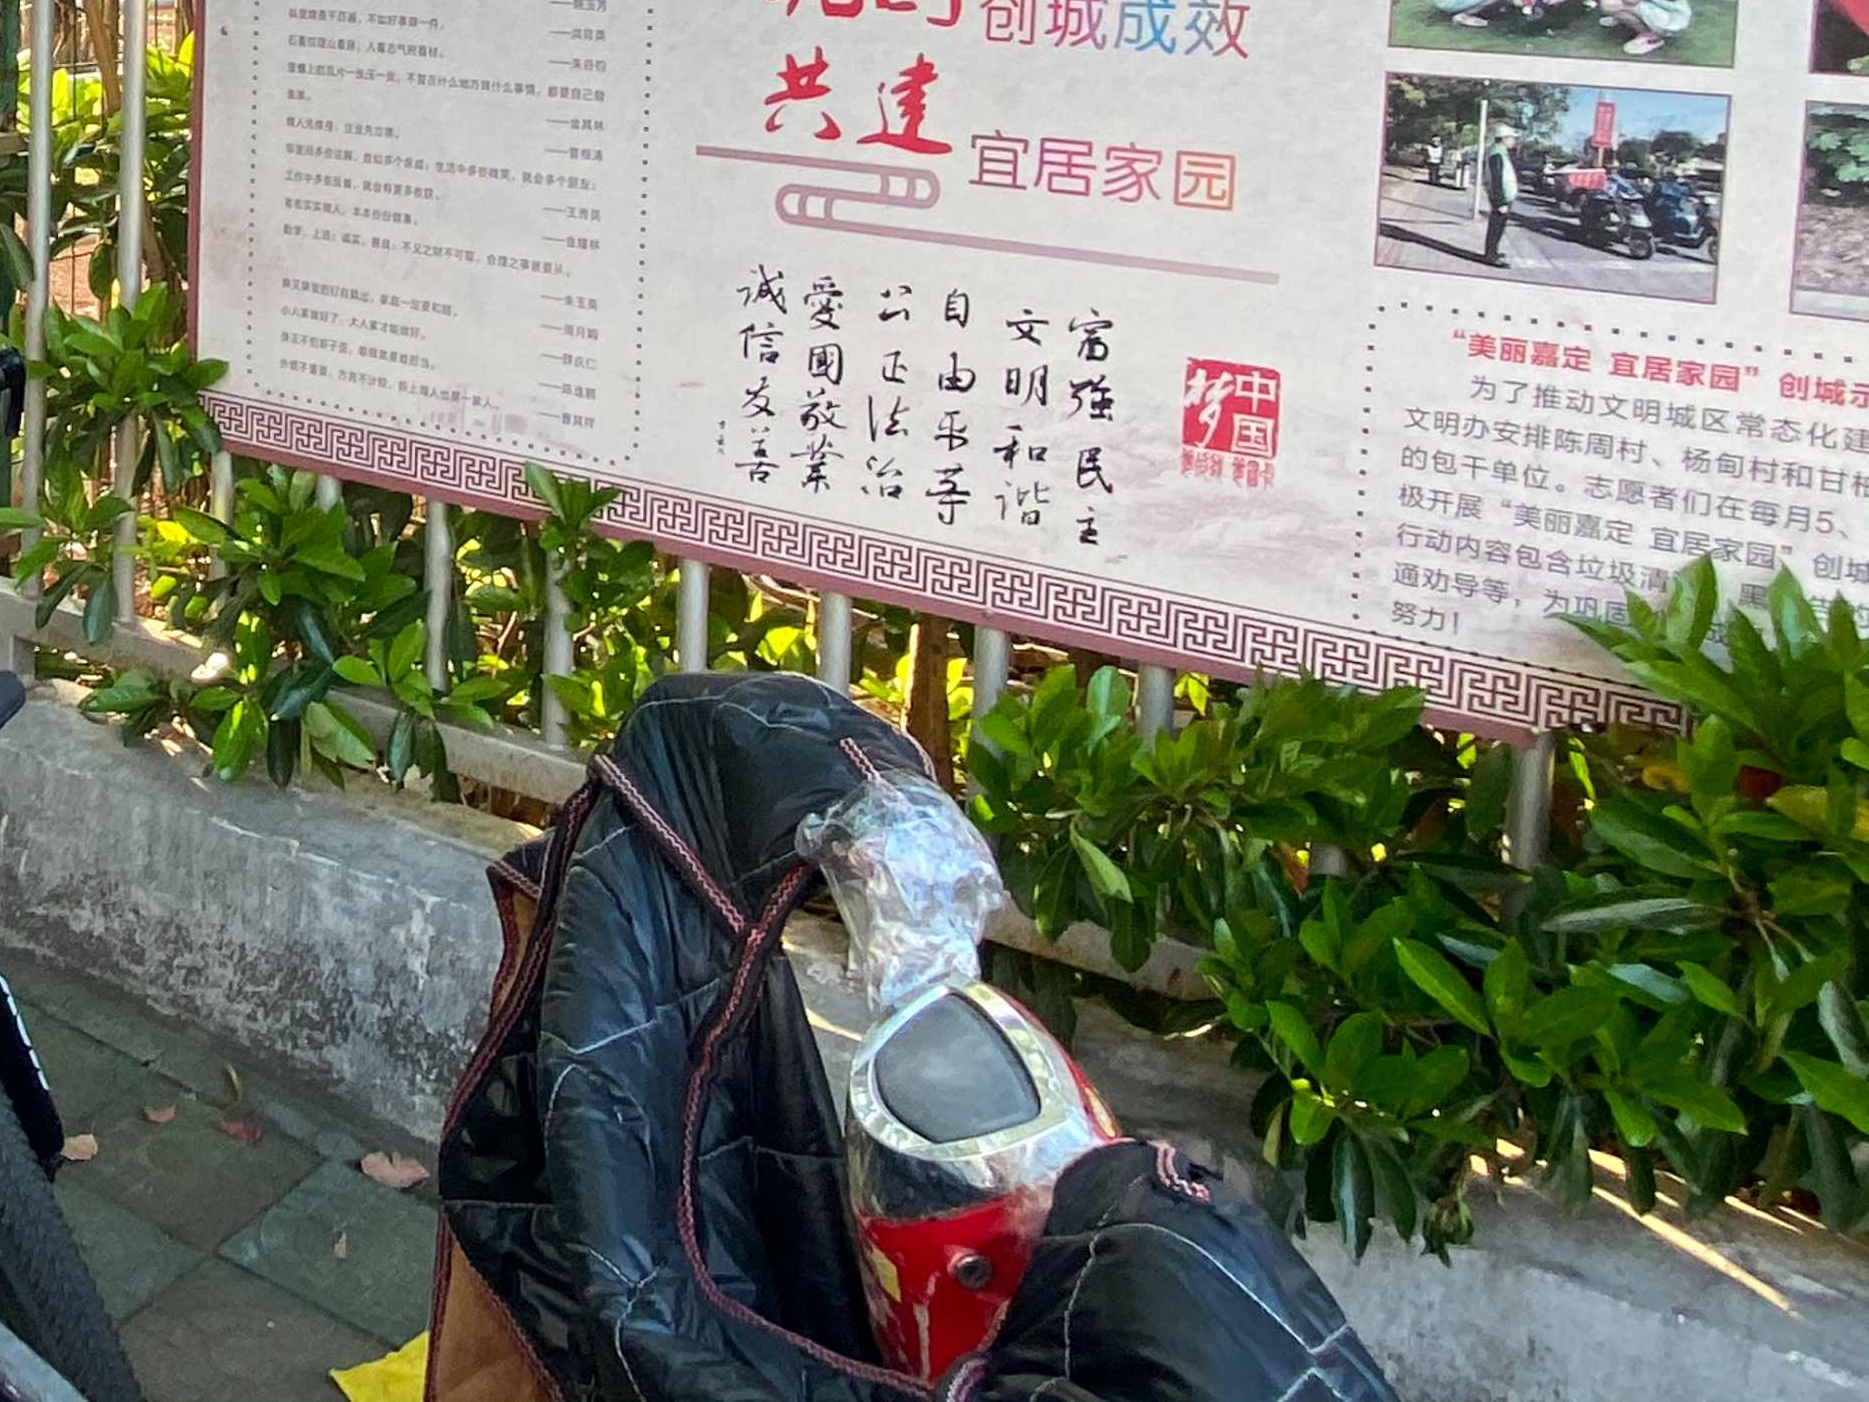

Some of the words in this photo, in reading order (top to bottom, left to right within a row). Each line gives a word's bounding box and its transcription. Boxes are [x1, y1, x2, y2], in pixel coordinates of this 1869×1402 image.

[764, 46, 953, 154] 共建
[968, 129, 1237, 212] 宜居家园
[926, 287, 977, 526] 自由平等
[1453, 329, 1592, 372] “美丽嘉定
[1469, 375, 1869, 455] 为了推动文明城区常态化建
